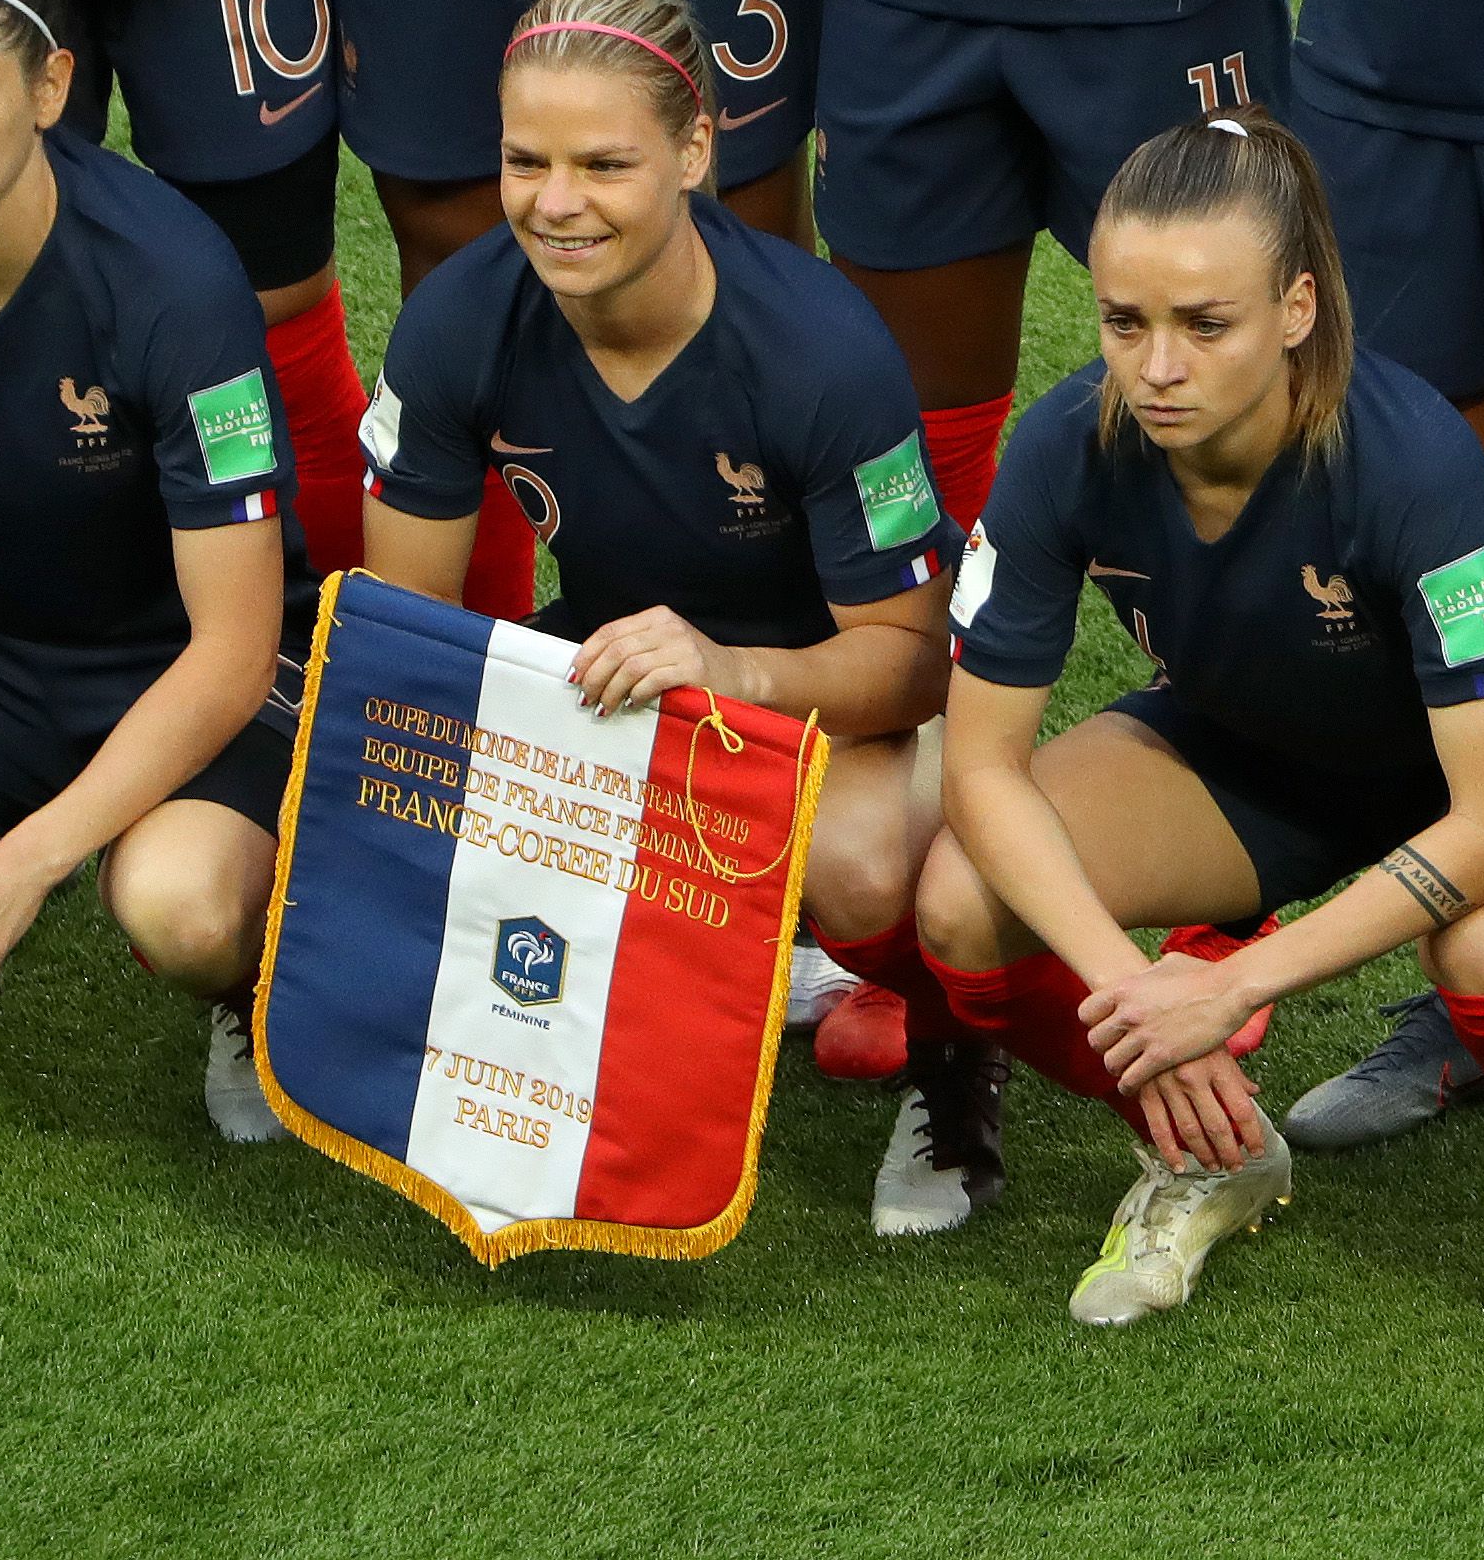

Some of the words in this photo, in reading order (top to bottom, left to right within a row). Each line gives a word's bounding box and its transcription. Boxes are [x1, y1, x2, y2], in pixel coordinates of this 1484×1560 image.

[361, 735, 461, 788] EQUIPE
[462, 766, 501, 803] DE
[503, 780, 612, 836] FRANCE
[613, 814, 740, 885] FEMININE
[364, 696, 430, 739] COUPE
[429, 714, 460, 746] DU
[459, 721, 530, 770] MONDE
[530, 745, 560, 779] DE
[559, 755, 587, 788] LA
[590, 763, 633, 801] FIFA
[635, 779, 711, 831] FRANCE
[711, 809, 750, 845] 2019
[355, 774, 613, 886] FRANCE-COREE
[614, 857, 666, 902] DU
[664, 877, 731, 929] SUD
[491, 1002, 551, 1032] FÉMININE
[500, 970, 551, 995] FRANCE
[425, 1044, 443, 1073] 7
[444, 1052, 526, 1099] JUIN
[529, 1079, 594, 1124] 2019
[453, 1096, 552, 1149] PARIS
